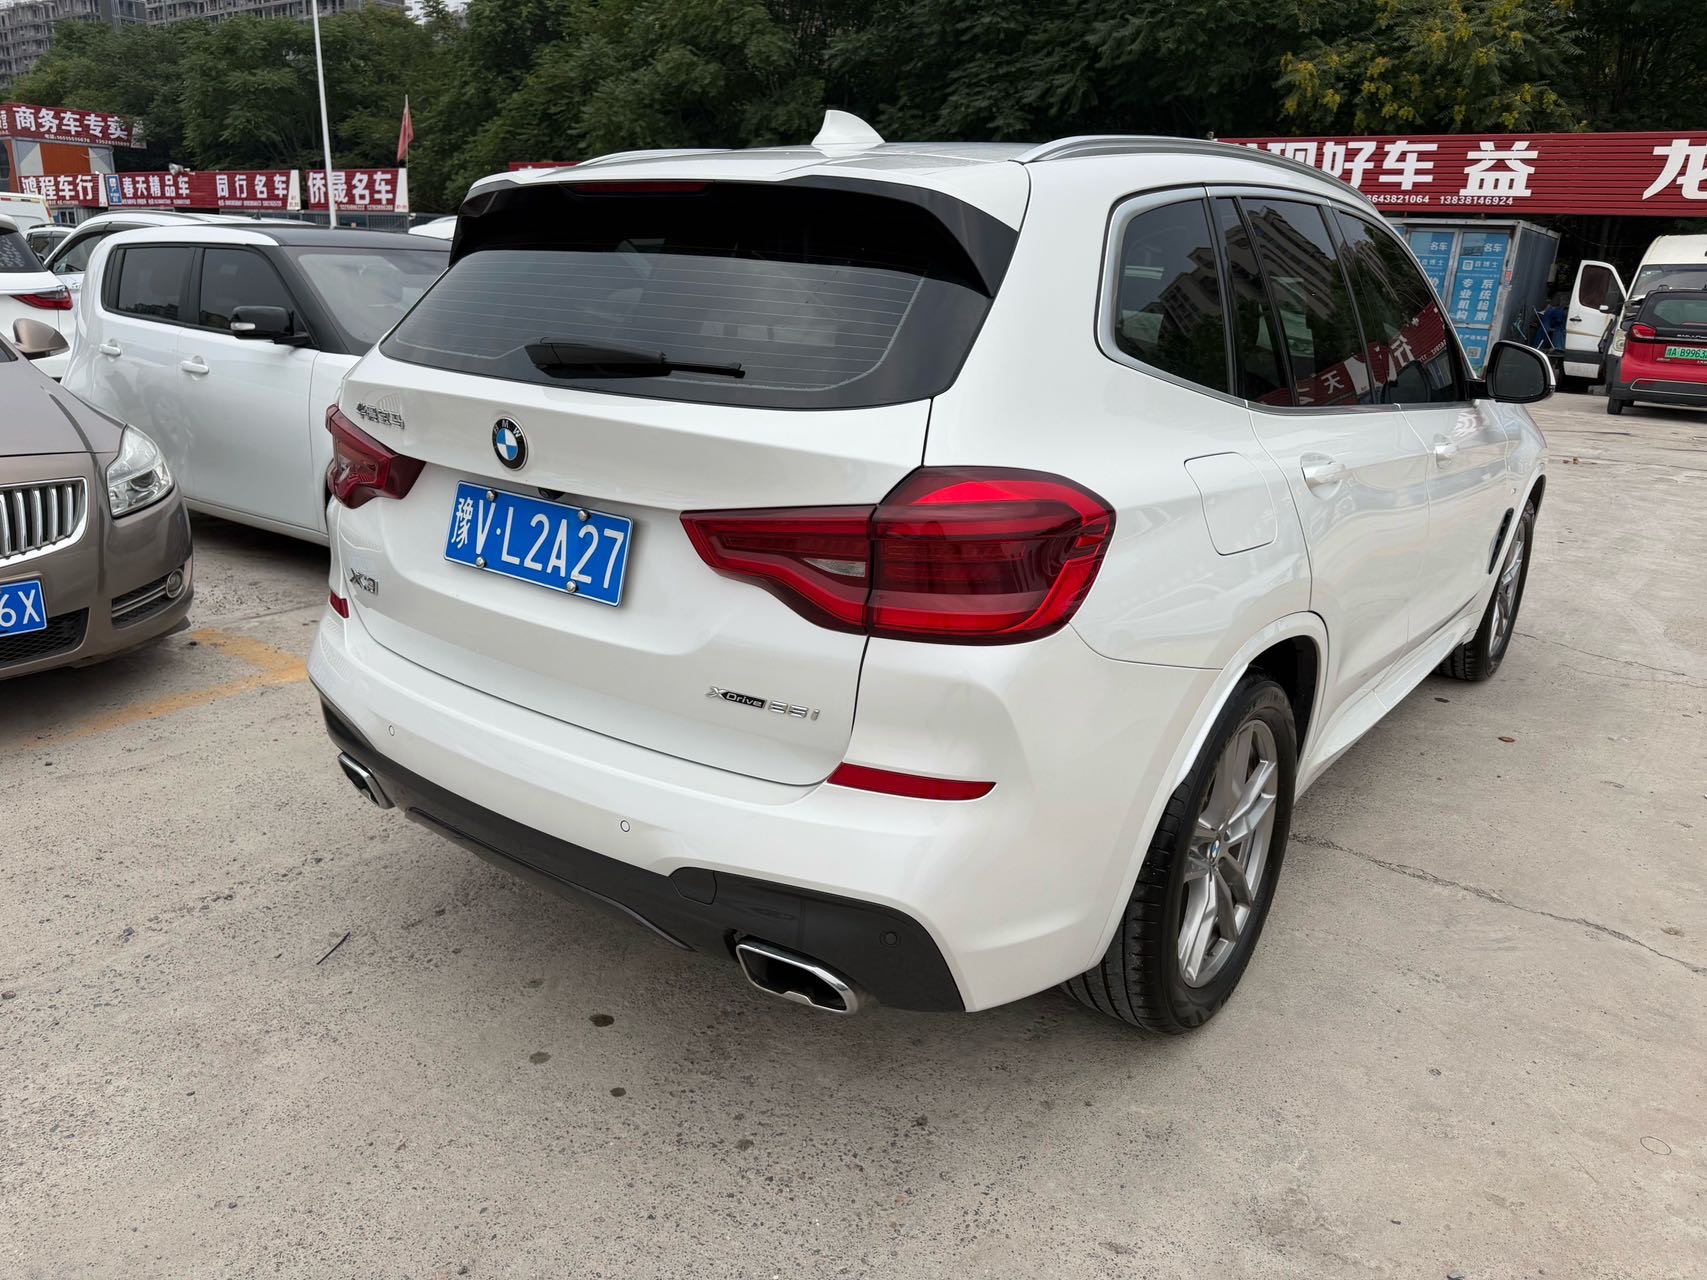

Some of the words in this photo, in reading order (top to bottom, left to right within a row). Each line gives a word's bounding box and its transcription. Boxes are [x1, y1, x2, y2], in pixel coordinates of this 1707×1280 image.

[12, 106, 128, 140] 商务车专卖
[1459, 141, 1539, 197] 益
[21, 175, 94, 200] 鸿程车行
[122, 175, 190, 197] 春天精品车
[216, 174, 287, 198] 同行名车
[1440, 195, 1513, 205] 13838146924
[1430, 242, 1448, 251] 名车
[1483, 243, 1502, 252] 名车
